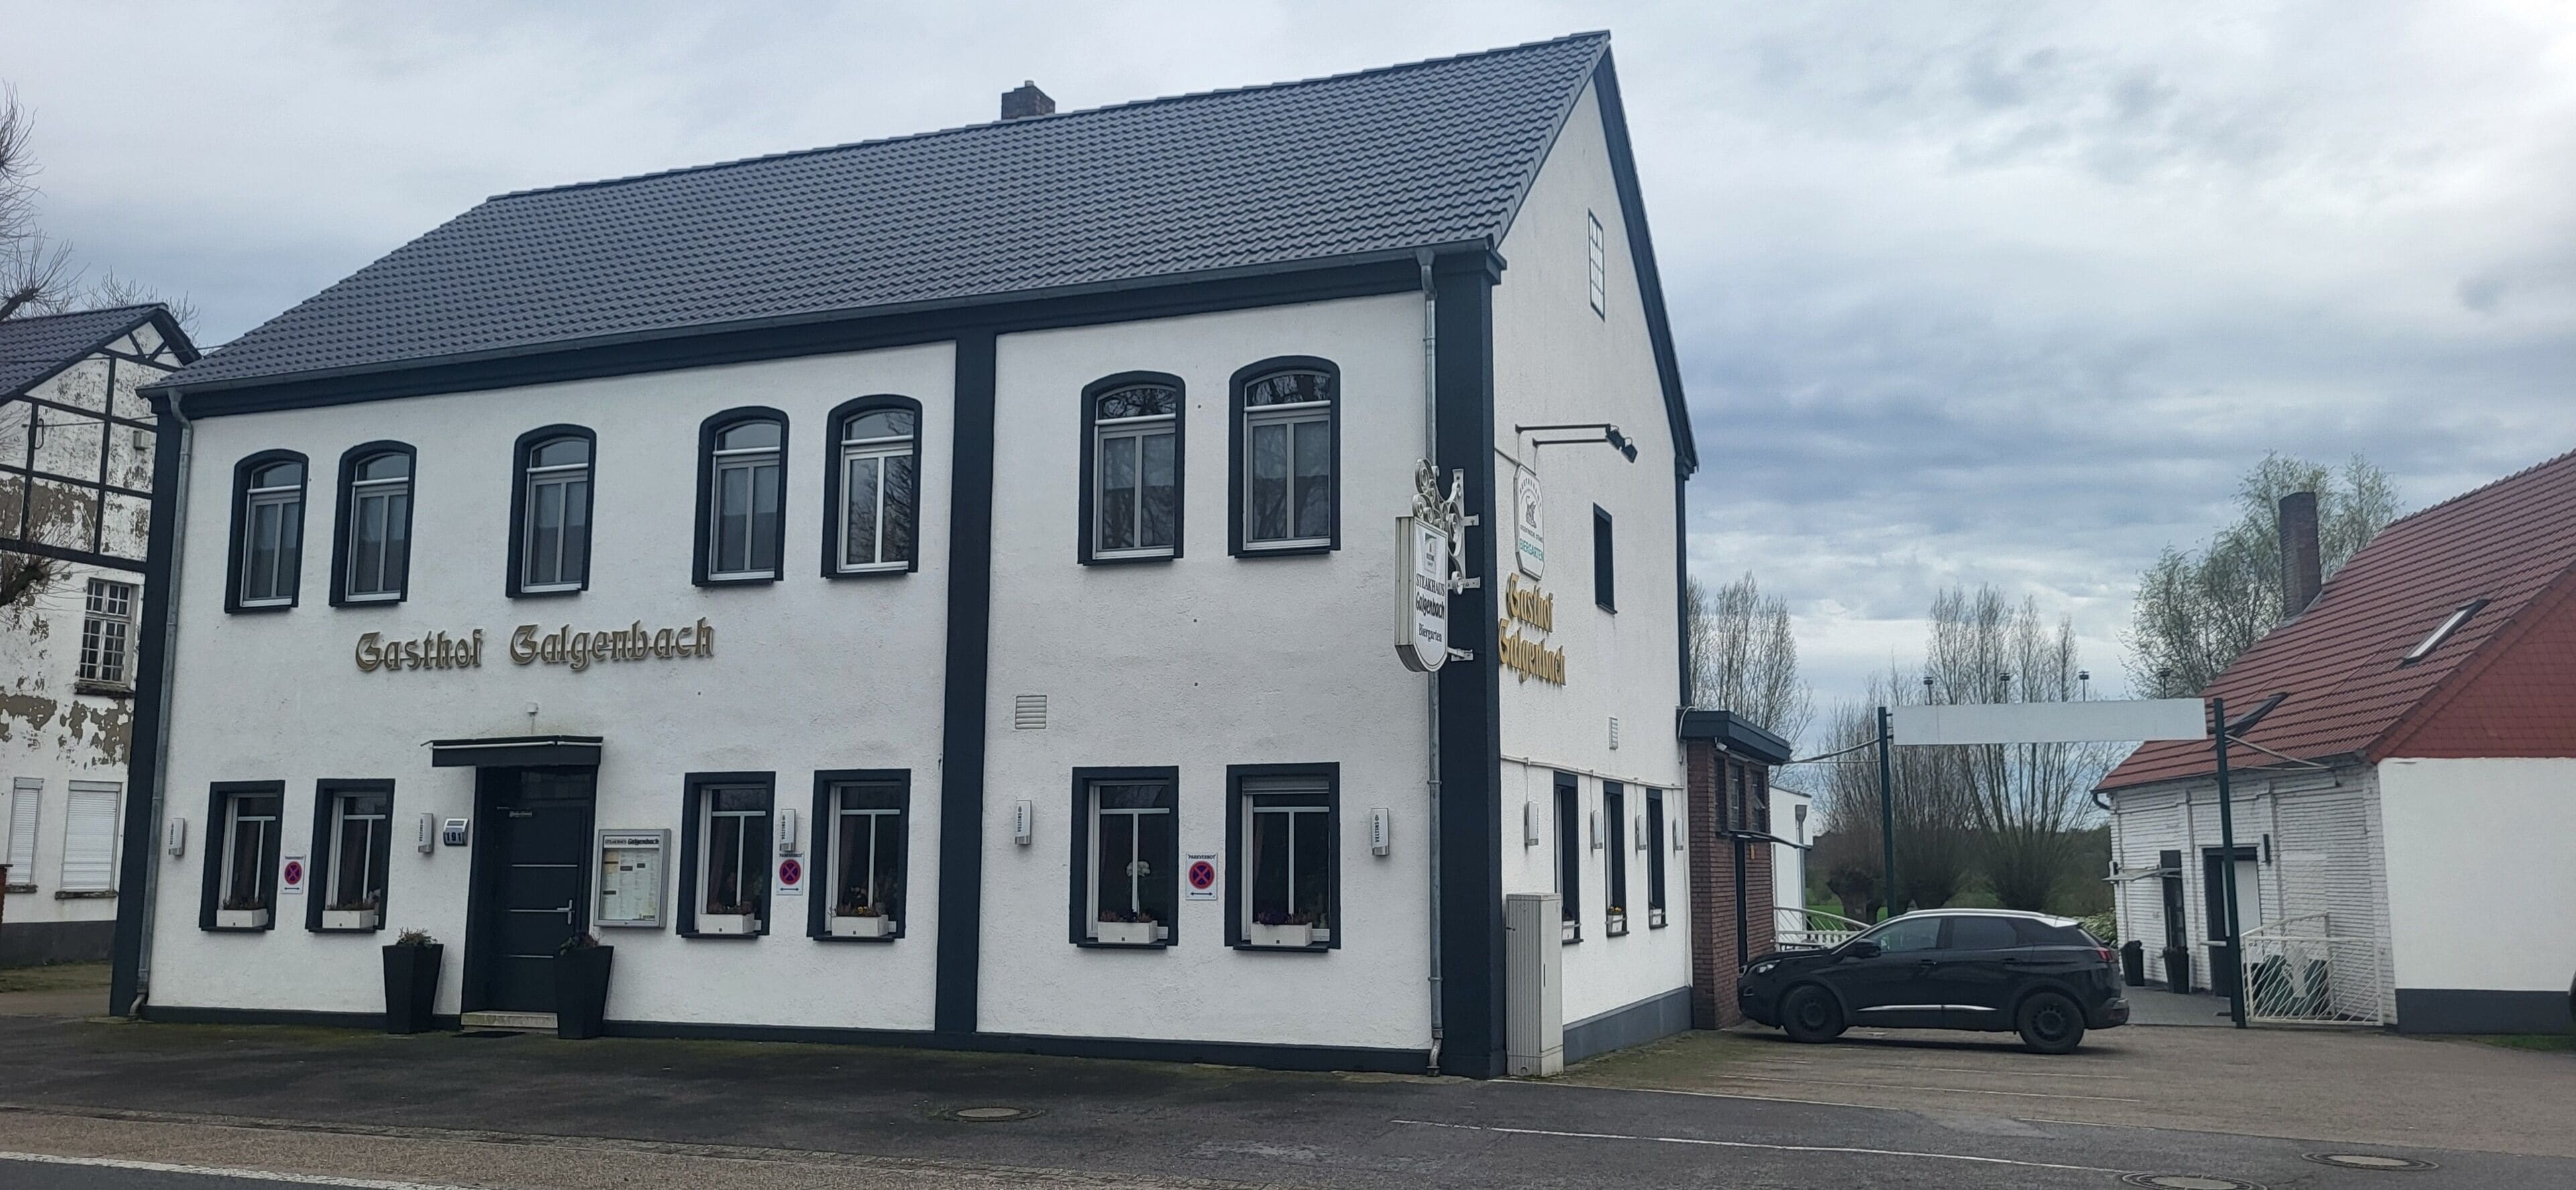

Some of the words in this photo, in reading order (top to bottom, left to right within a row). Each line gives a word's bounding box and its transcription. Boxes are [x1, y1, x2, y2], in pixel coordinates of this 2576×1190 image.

[1519, 538, 1544, 561] BIERGARTEN
[1415, 573, 1445, 596] STEAKHAUS
[1415, 591, 1445, 619] Galgenbach
[1506, 573, 1553, 633] Gasthof
[355, 629, 484, 671] Gasthof
[509, 616, 715, 671] Galgenbach
[1418, 623, 1442, 643] Biergarten
[1499, 618, 1566, 686] Galgenbach
[445, 832, 462, 842] 191
